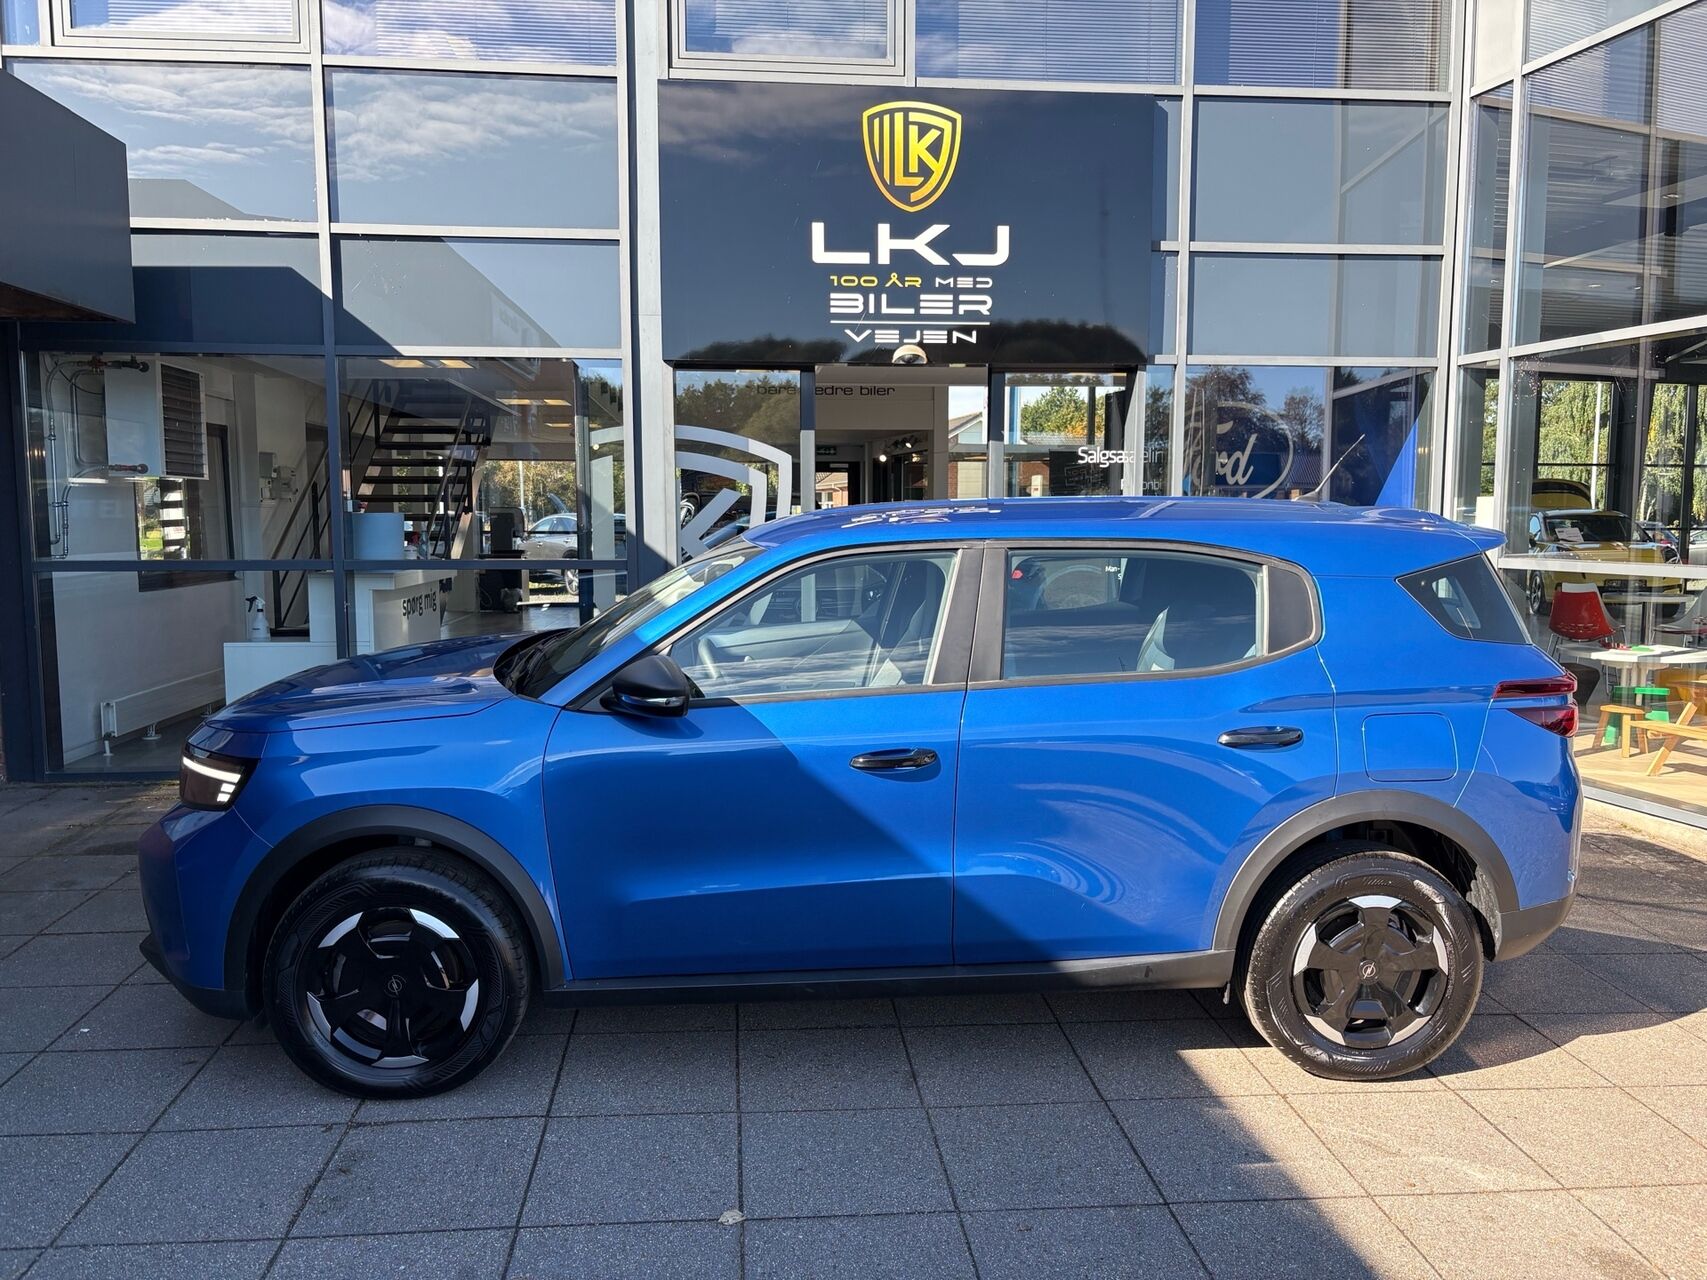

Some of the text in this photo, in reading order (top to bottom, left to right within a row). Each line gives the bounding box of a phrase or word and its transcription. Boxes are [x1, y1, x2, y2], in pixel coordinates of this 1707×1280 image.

[811, 221, 1010, 267] LKJ
[830, 272, 993, 289] 100 ÅR MED
[829, 292, 993, 316] BILER
[844, 329, 977, 344] VEJEN
[814, 385, 854, 396] edre
[859, 385, 896, 396] biler
[424, 588, 437, 612] mig
